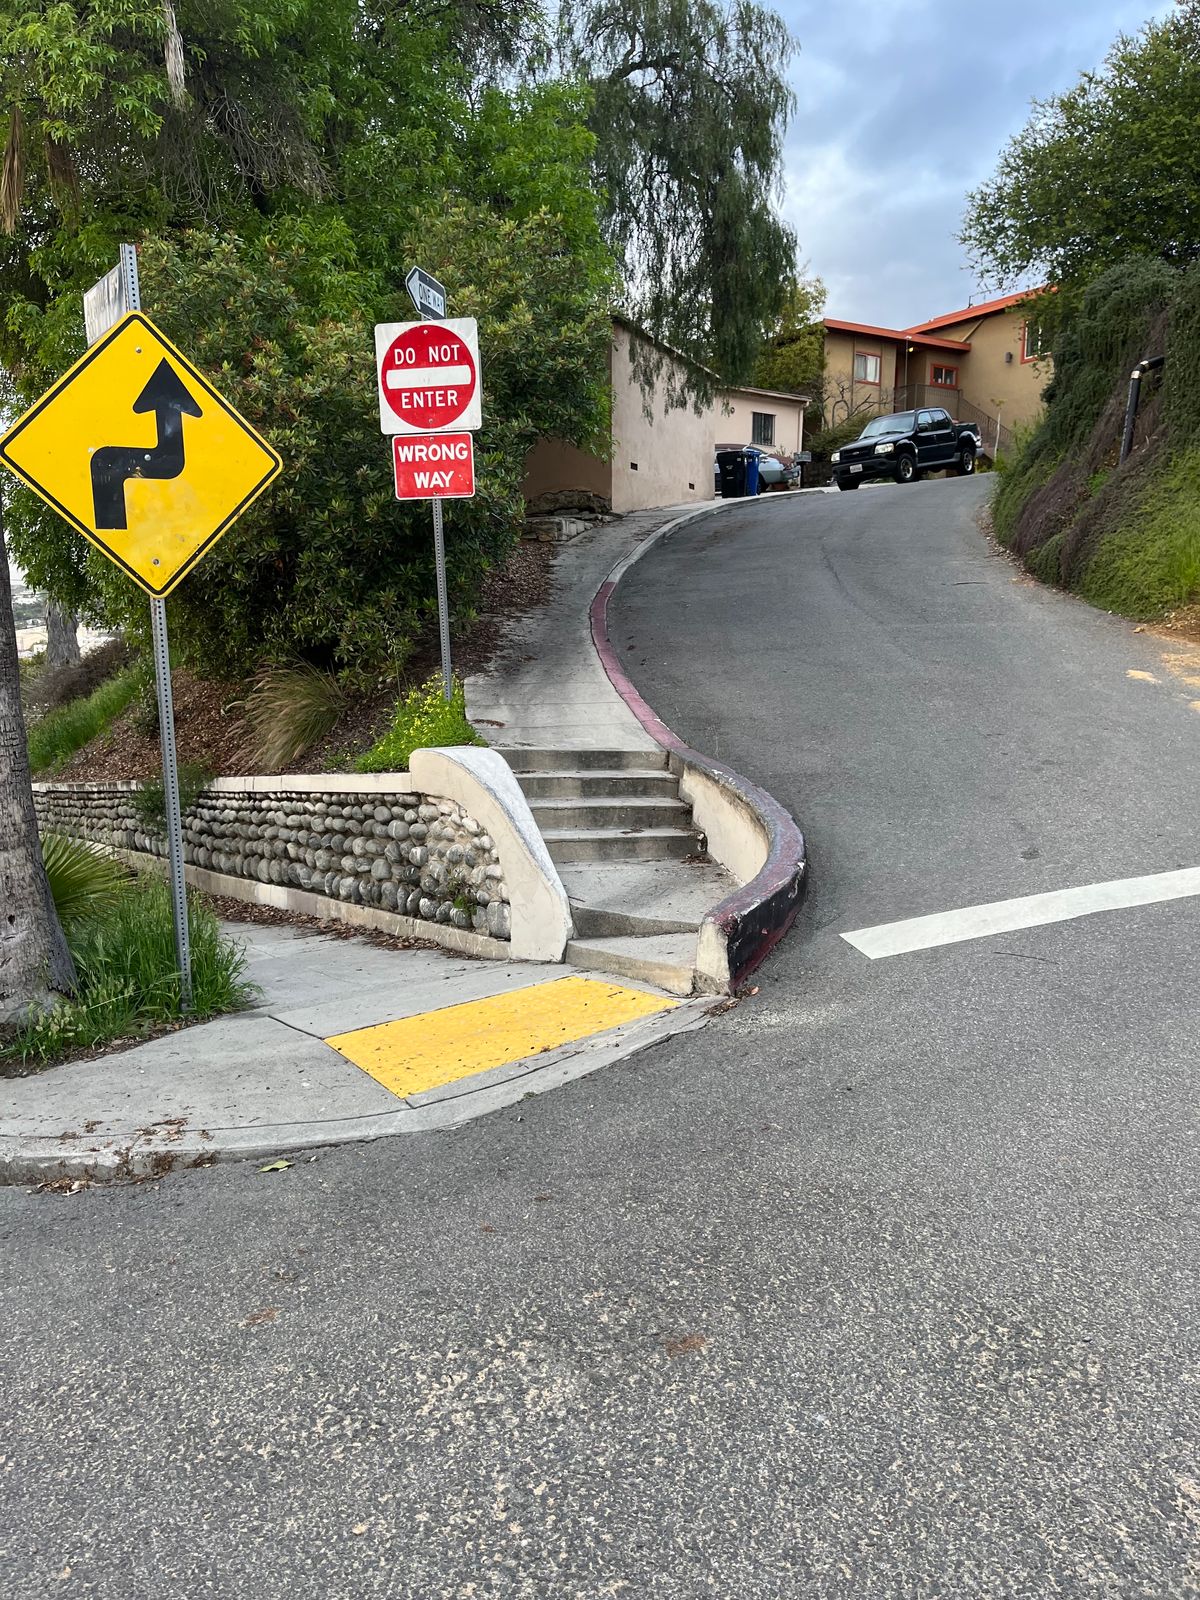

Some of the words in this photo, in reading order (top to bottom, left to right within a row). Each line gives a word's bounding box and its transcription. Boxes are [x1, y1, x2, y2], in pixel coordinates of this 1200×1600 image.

[418, 283, 431, 305] ONE
[432, 292, 443, 314] WAY
[394, 347, 416, 365] DO
[428, 344, 460, 362] NOT
[401, 390, 458, 409] ENTER
[398, 442, 468, 463] WRONG
[414, 470, 454, 489] WAY
